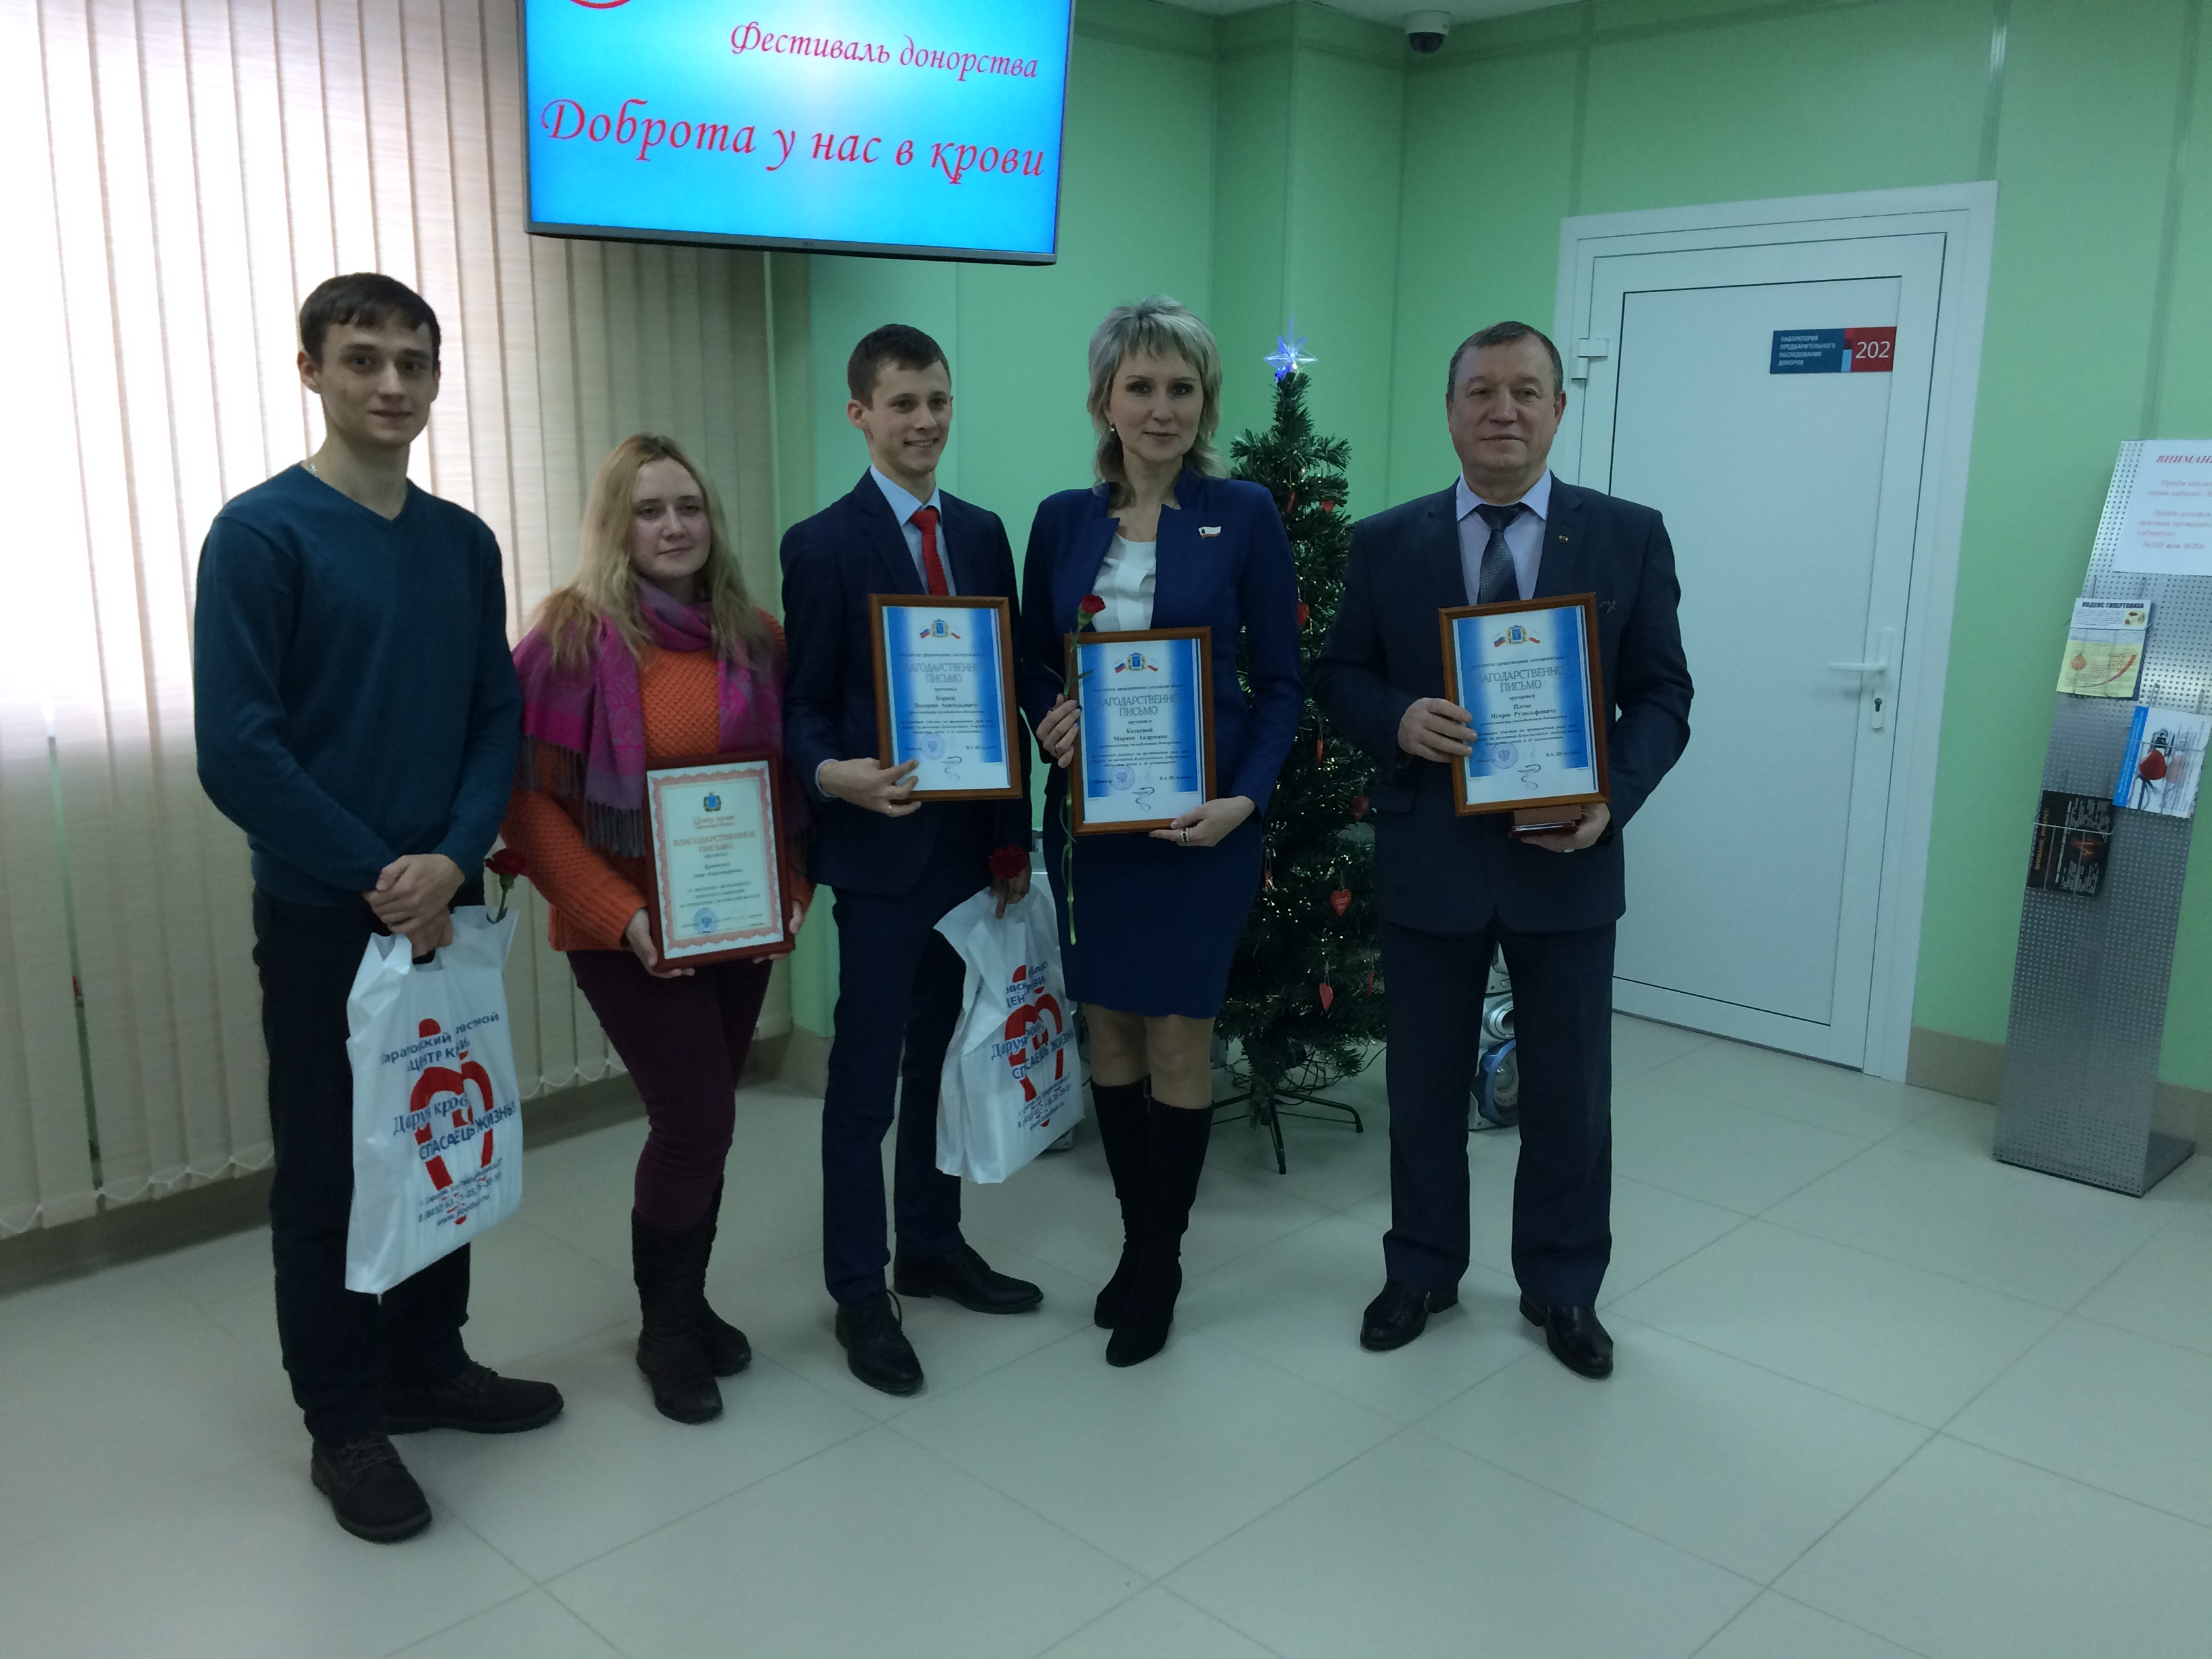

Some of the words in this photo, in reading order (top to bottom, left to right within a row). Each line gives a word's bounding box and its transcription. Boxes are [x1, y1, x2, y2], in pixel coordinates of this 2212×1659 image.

[730, 21, 891, 64] Фестиваль
[899, 35, 1038, 82] донорства
[541, 99, 756, 161] Доброта
[766, 127, 796, 171] у
[812, 132, 881, 164] нас
[895, 141, 914, 167] в
[930, 140, 1044, 184] крови
[1855, 340, 1891, 359] 202
[925, 674, 962, 683] ПИСЬМО
[1500, 680, 1542, 692] ПИСЬМО
[1119, 706, 1158, 716] ПИСЬМО
[673, 831, 756, 846] БЛАГОДАРСТВЕННОЕ
[699, 842, 733, 853] ПИСЬМО
